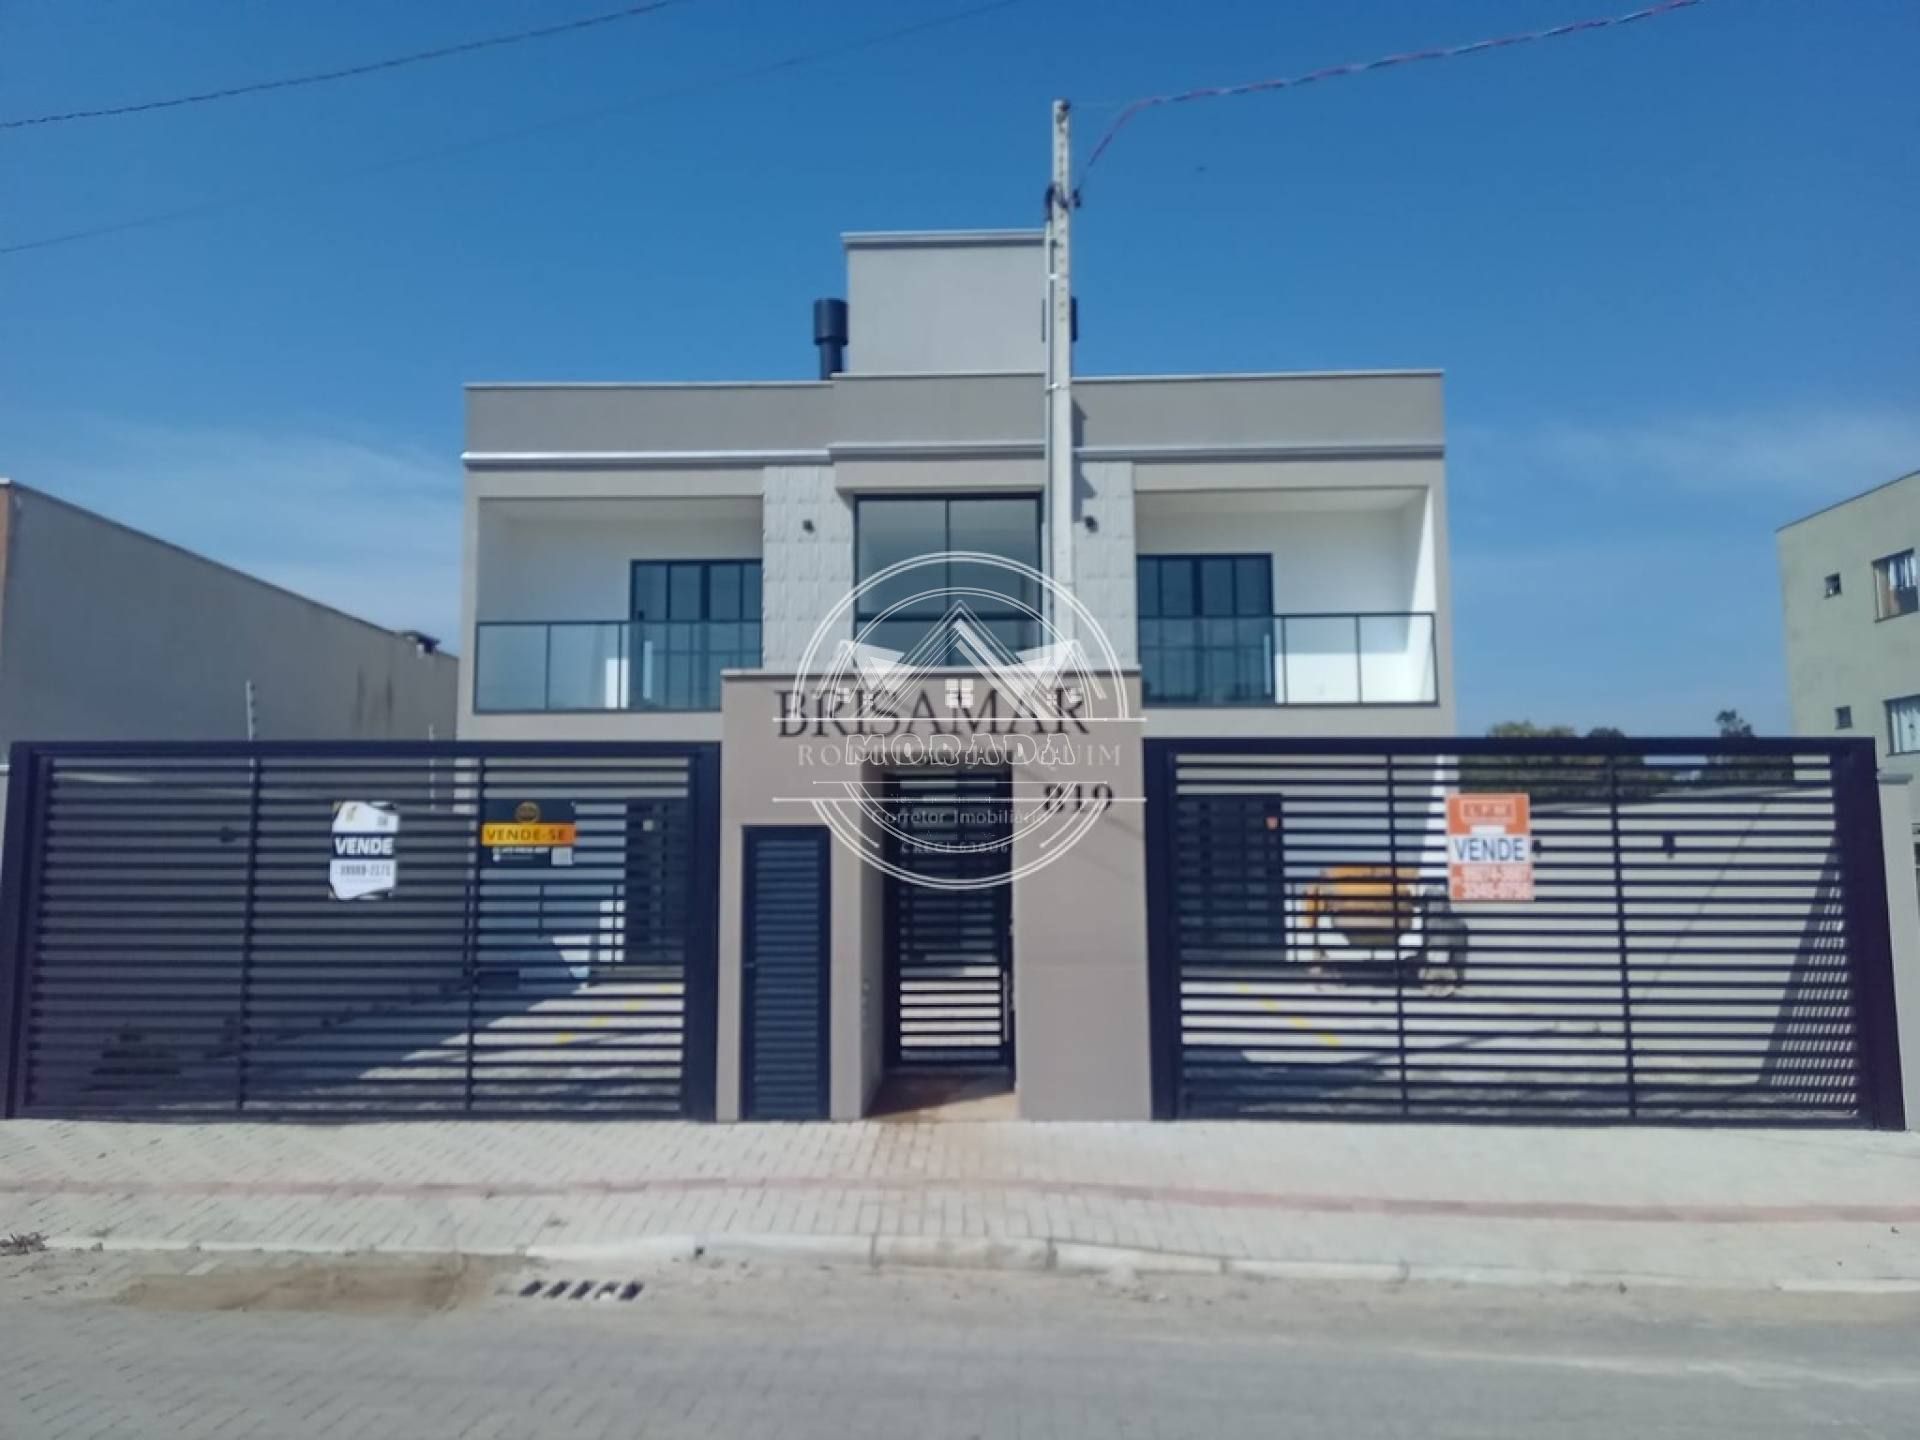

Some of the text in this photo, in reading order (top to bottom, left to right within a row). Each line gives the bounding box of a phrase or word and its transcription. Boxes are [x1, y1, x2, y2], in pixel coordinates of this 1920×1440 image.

[775, 688, 1090, 738] BRISAMAR
[335, 837, 393, 855] VENDE
[1453, 838, 1525, 861] VENDE
